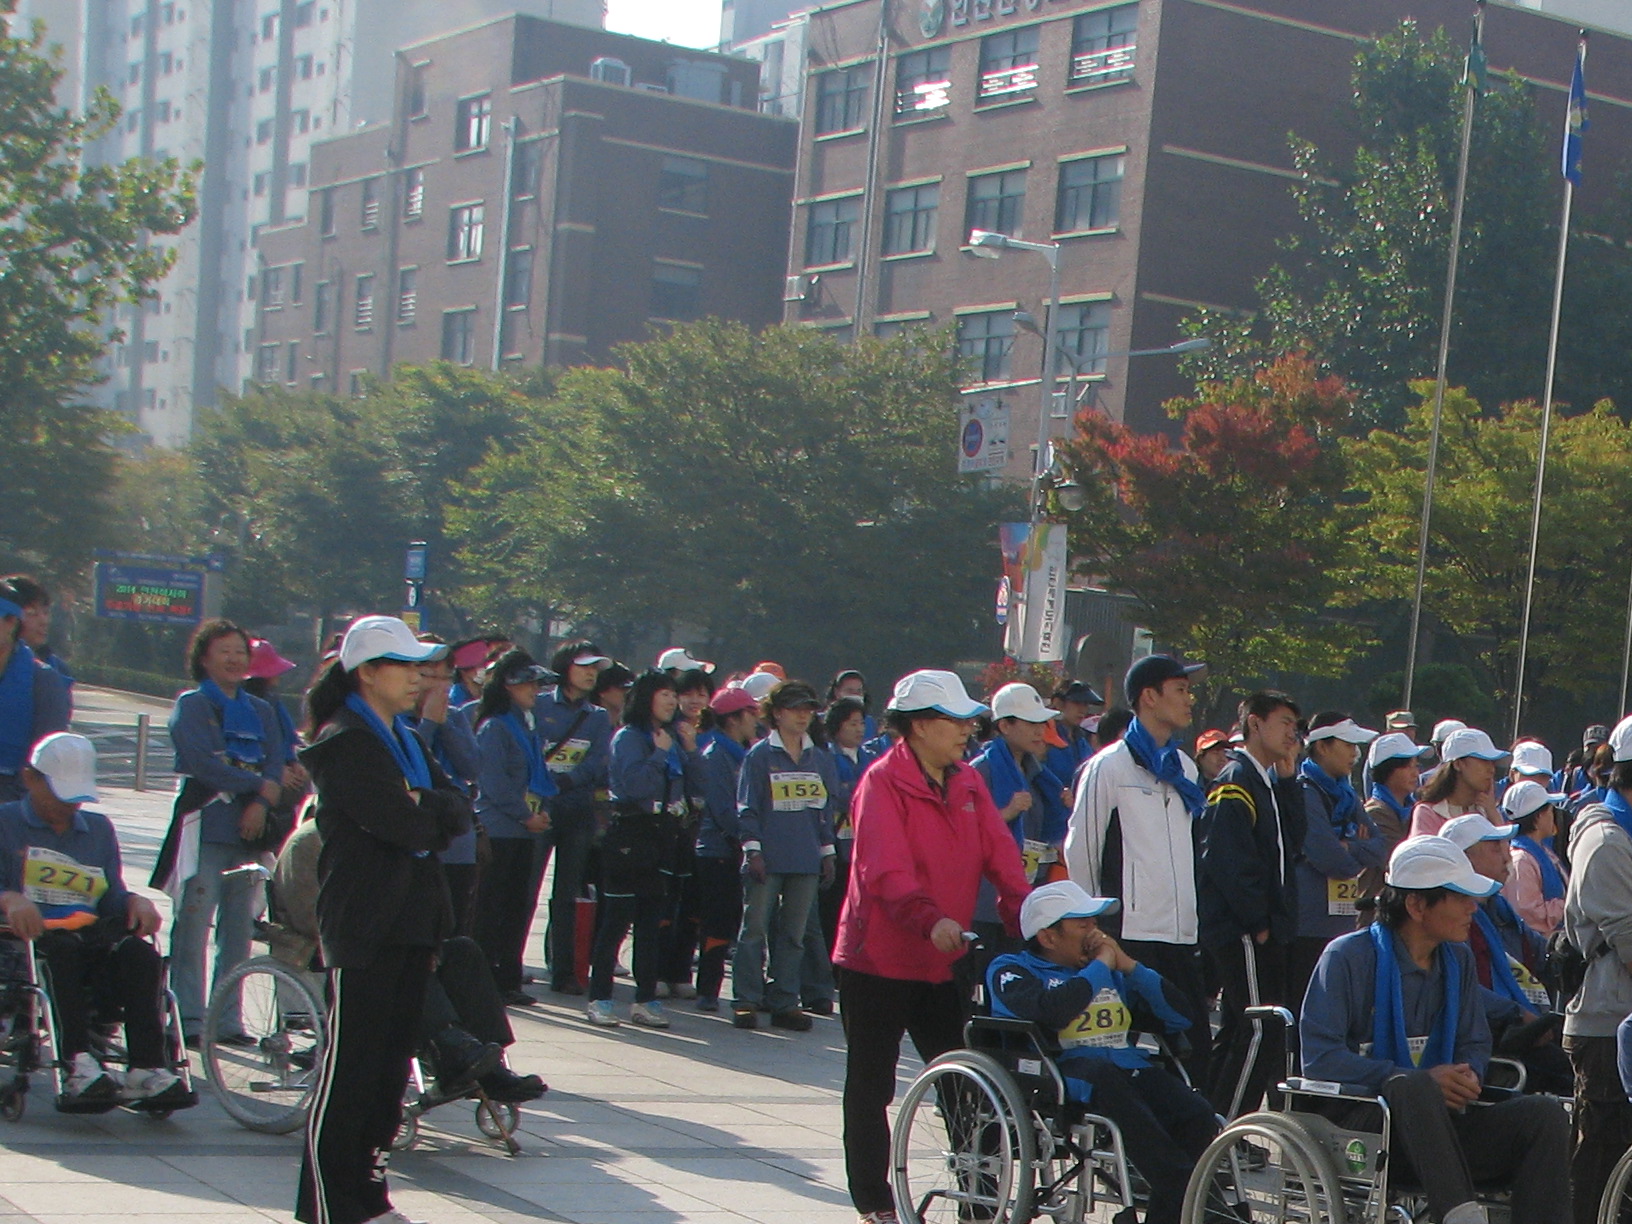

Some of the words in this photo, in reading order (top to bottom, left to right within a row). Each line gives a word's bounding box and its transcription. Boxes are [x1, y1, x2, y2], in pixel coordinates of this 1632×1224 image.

[781, 784, 821, 797] 152
[38, 866, 95, 892] 271
[1075, 1007, 1125, 1033] 281
